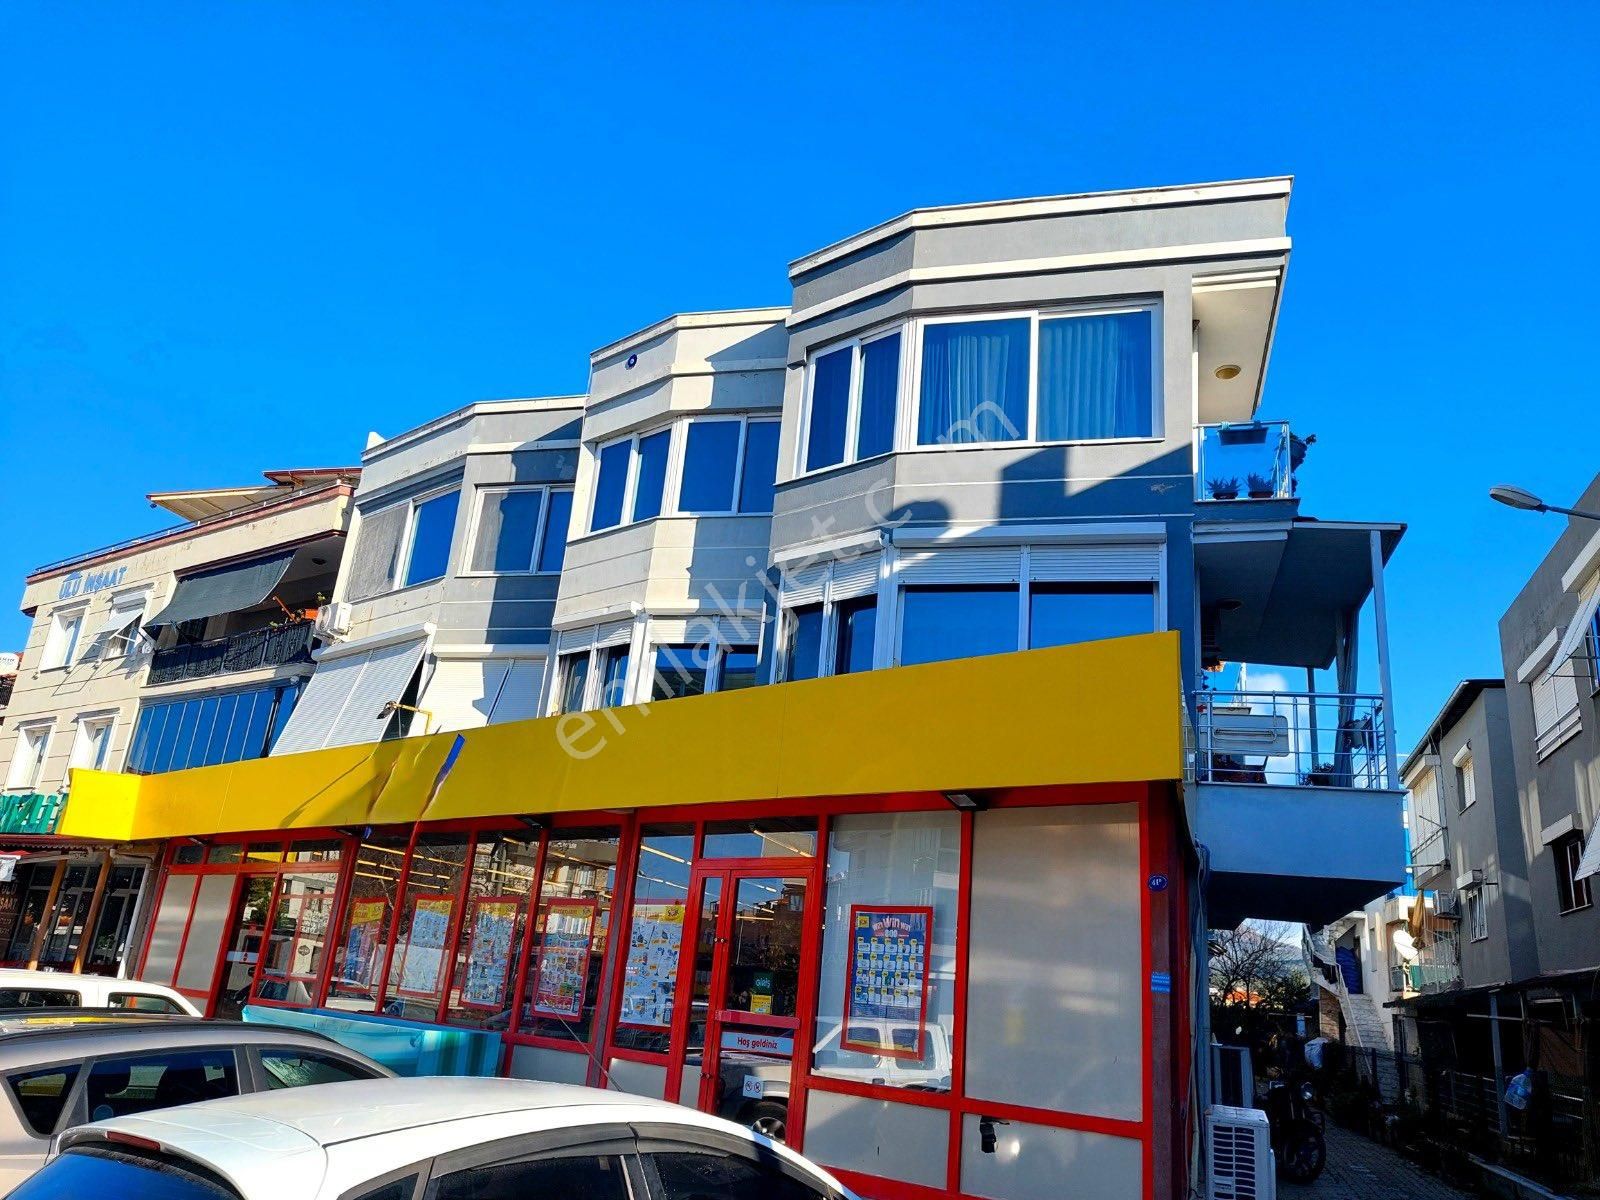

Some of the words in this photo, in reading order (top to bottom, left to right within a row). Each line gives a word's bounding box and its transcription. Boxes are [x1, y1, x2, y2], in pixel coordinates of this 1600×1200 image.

[58, 578, 82, 599] ULU
[737, 1036, 750, 1047] Hoş
[751, 1038, 778, 1049] geldiniz
